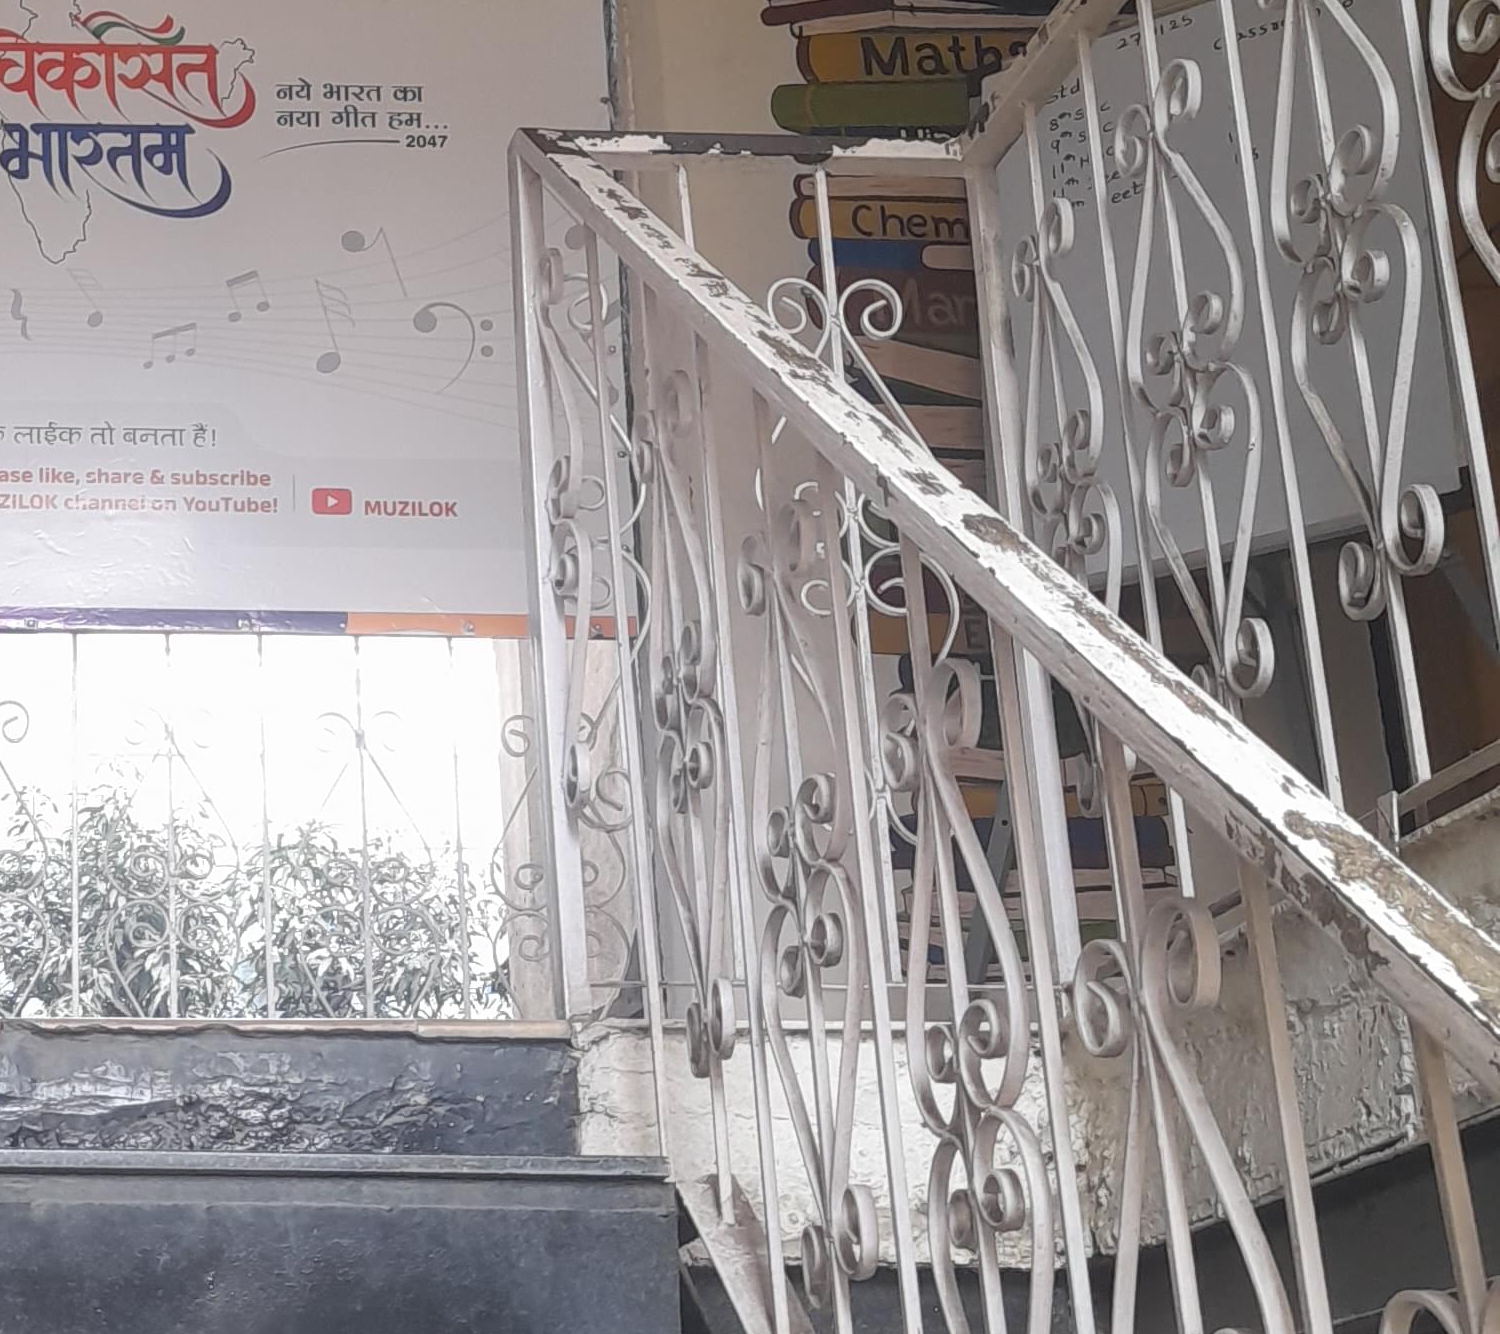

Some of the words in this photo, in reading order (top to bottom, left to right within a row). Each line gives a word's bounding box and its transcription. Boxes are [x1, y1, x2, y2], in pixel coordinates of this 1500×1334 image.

[275, 77, 312, 101] नये
[322, 83, 383, 102] भारत
[392, 85, 423, 102] का
[275, 111, 320, 128] नया
[331, 104, 378, 128] गीत
[405, 134, 448, 148] 2047
[0, 123, 232, 218] भारतम
[13, 421, 83, 445] लाईक
[90, 421, 116, 445] तो
[123, 427, 186, 447] बनता
[39, 467, 80, 486] like,
[85, 468, 144, 485] share
[149, 470, 165, 486] &
[170, 468, 271, 487] subscribe
[183, 496, 278, 514] YouTube!
[364, 499, 458, 517] MUZILOK
